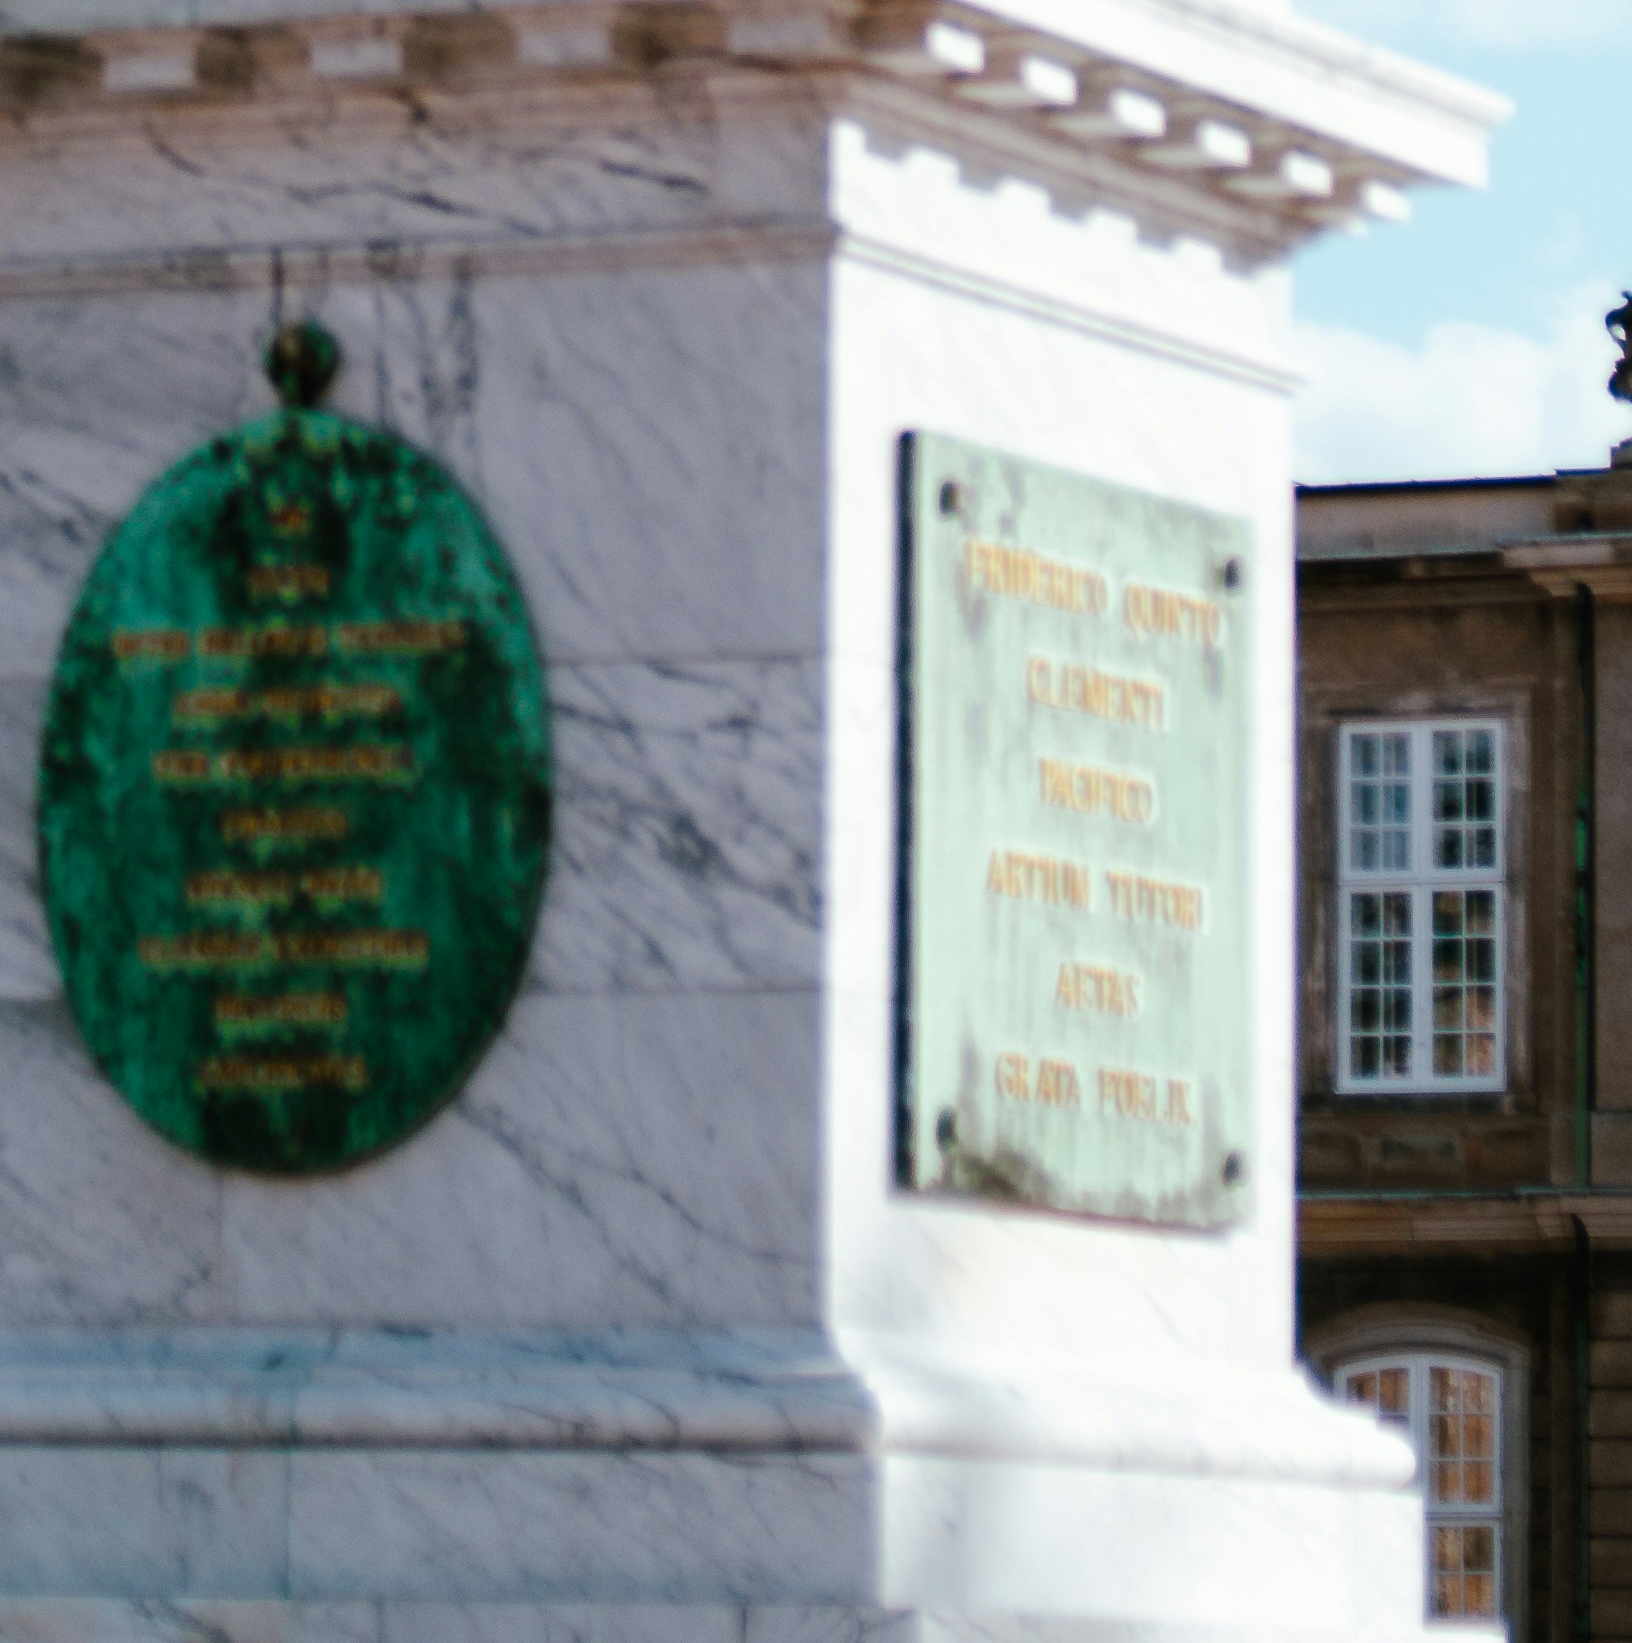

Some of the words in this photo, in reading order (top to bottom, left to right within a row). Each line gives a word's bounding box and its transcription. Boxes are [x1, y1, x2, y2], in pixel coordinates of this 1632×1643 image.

[963, 540, 1108, 616] FRIDERICO
[1123, 582, 1220, 646] QUINTO
[1026, 655, 1163, 727] CLEMENTI
[1039, 756, 1152, 825] PACIFICO
[986, 849, 1091, 910] ARTIUM
[1105, 870, 1204, 932] TUTORI
[1054, 962, 1140, 1019] AETAS
[994, 1051, 1081, 1109] GRATA
